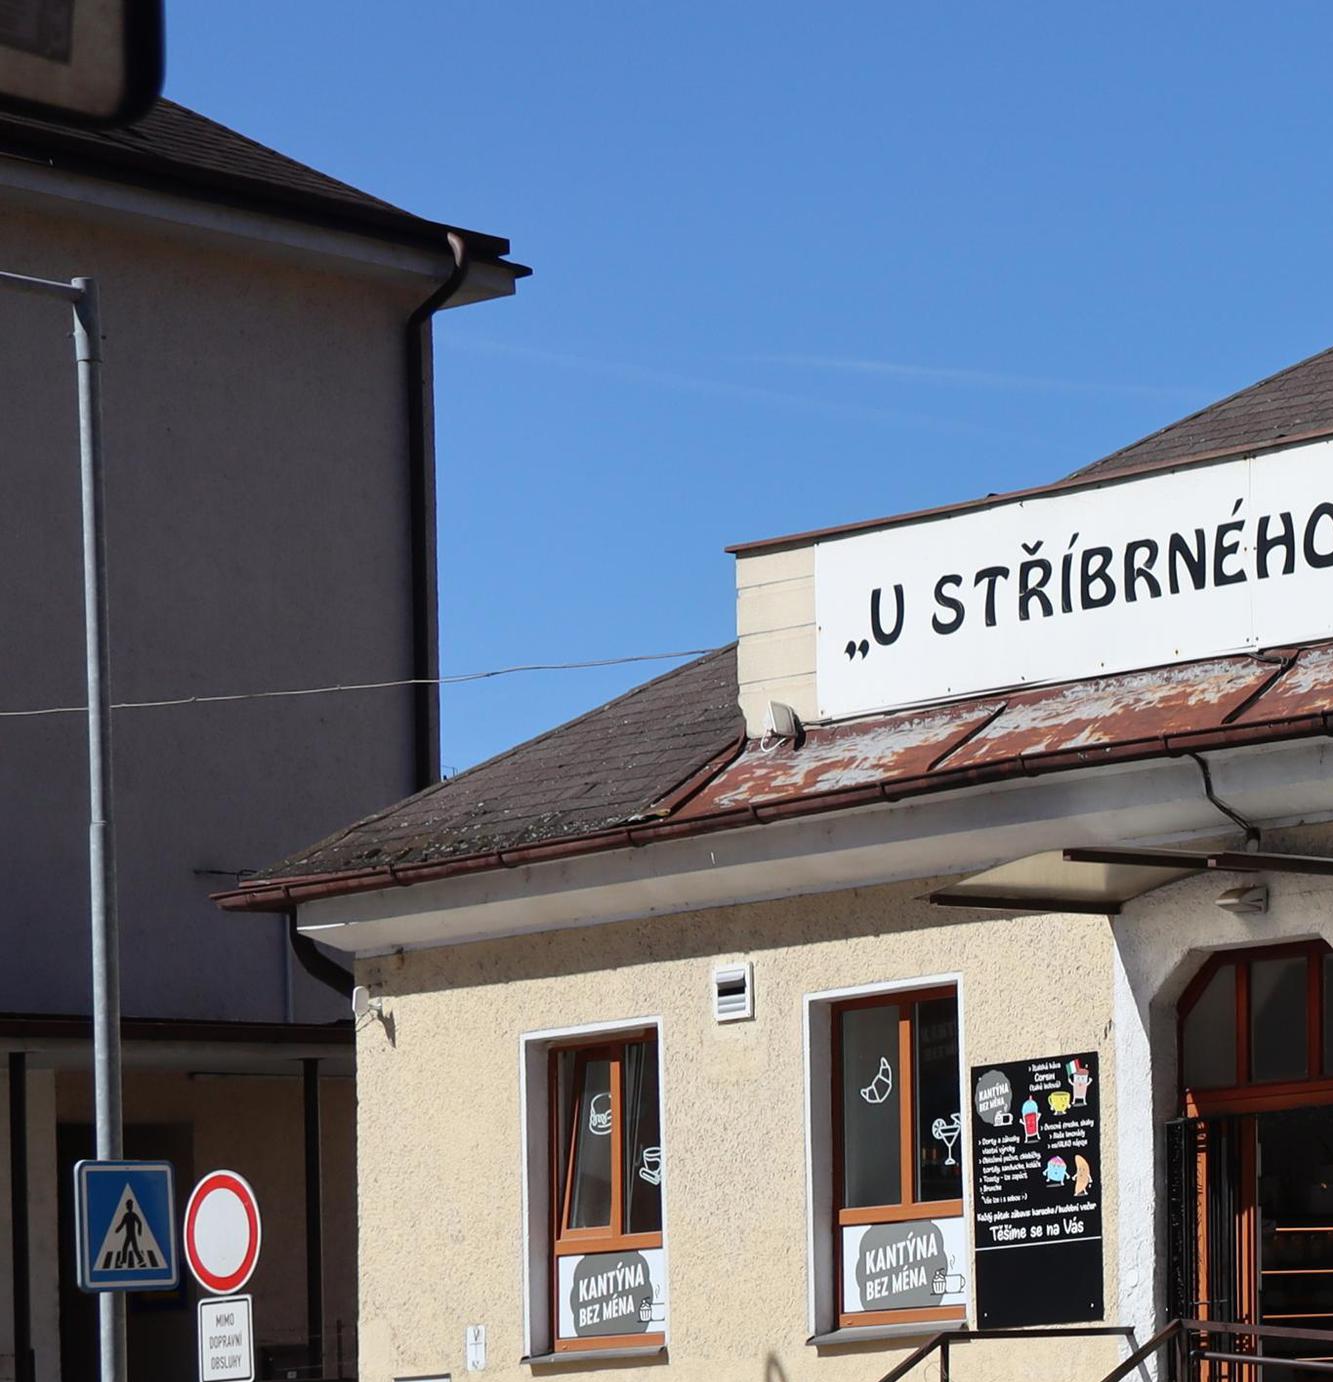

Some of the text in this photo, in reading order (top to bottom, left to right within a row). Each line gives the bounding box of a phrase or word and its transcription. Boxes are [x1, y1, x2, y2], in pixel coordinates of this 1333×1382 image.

[979, 1082, 1009, 1101] KANTÝNA
[979, 1102, 989, 1112] BEZ
[989, 1216, 1084, 1242] Těšíme se na Vás
[865, 1231, 938, 1275] KANTÝNA
[579, 1261, 644, 1302] KANTÝNA
[866, 1264, 927, 1301] BEZ MÉNA
[215, 1312, 235, 1328] MIMO
[579, 1293, 635, 1327] BEZ MÉNA
[209, 1332, 243, 1350] DOPRAVNÍ
[211, 1354, 242, 1370] OBSLUHY
